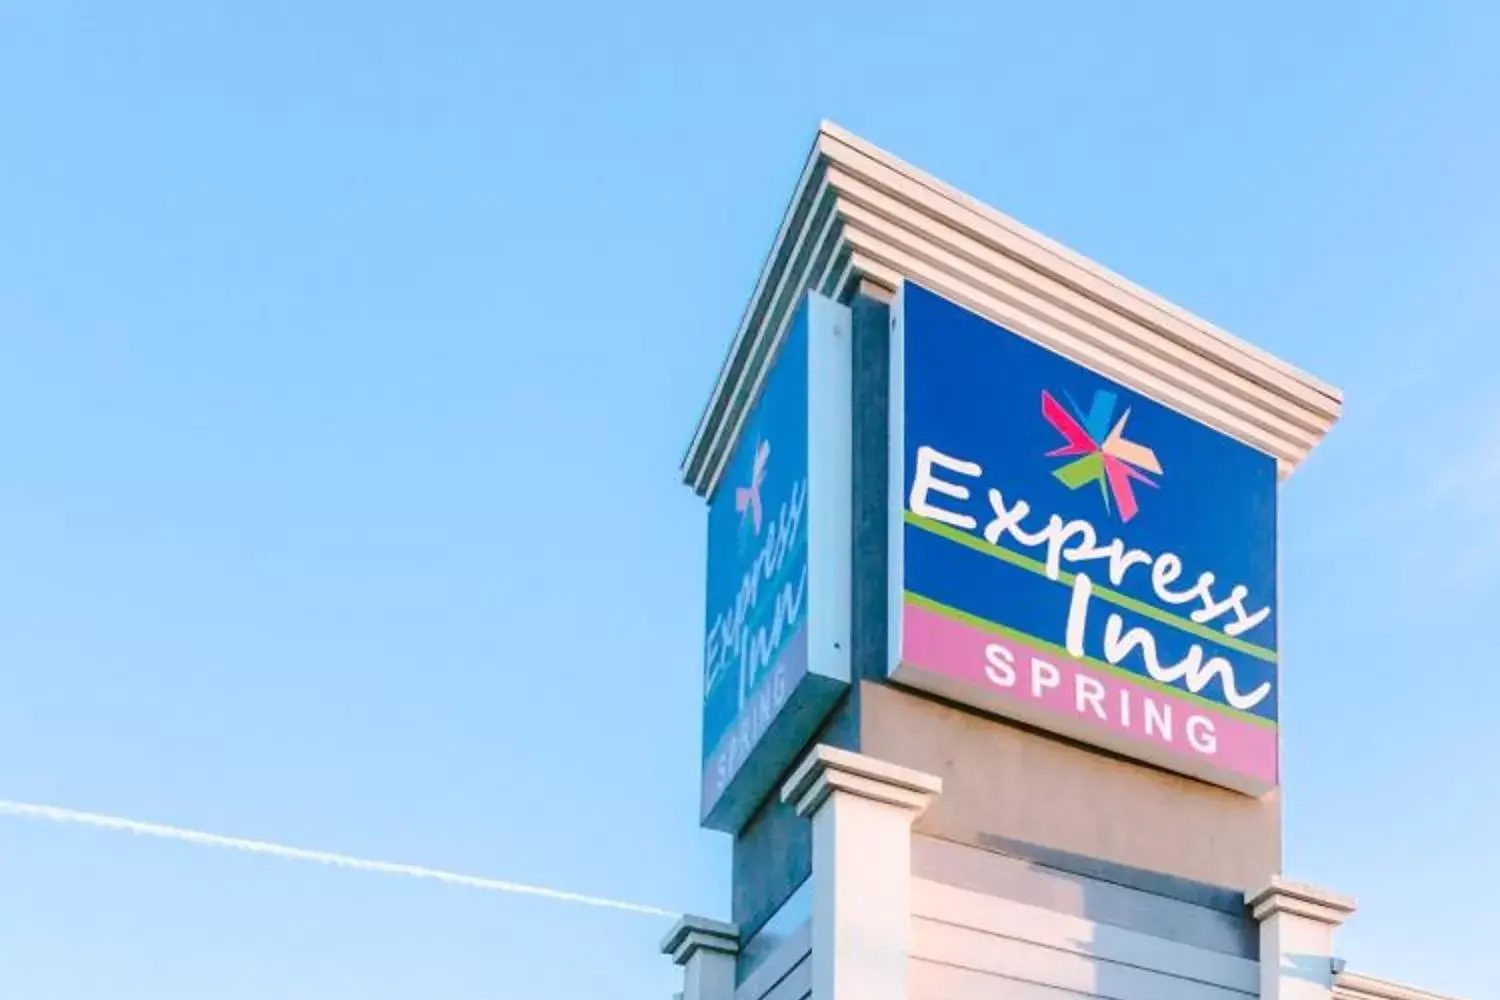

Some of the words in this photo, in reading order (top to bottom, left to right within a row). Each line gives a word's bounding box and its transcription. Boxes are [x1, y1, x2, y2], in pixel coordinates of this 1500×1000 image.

[704, 477, 807, 698] Express
[909, 446, 1271, 637] Express
[739, 563, 807, 710] Inn
[983, 643, 1219, 755] SPRING
[1065, 573, 1271, 709] Inn
[716, 665, 786, 790] SPRING
